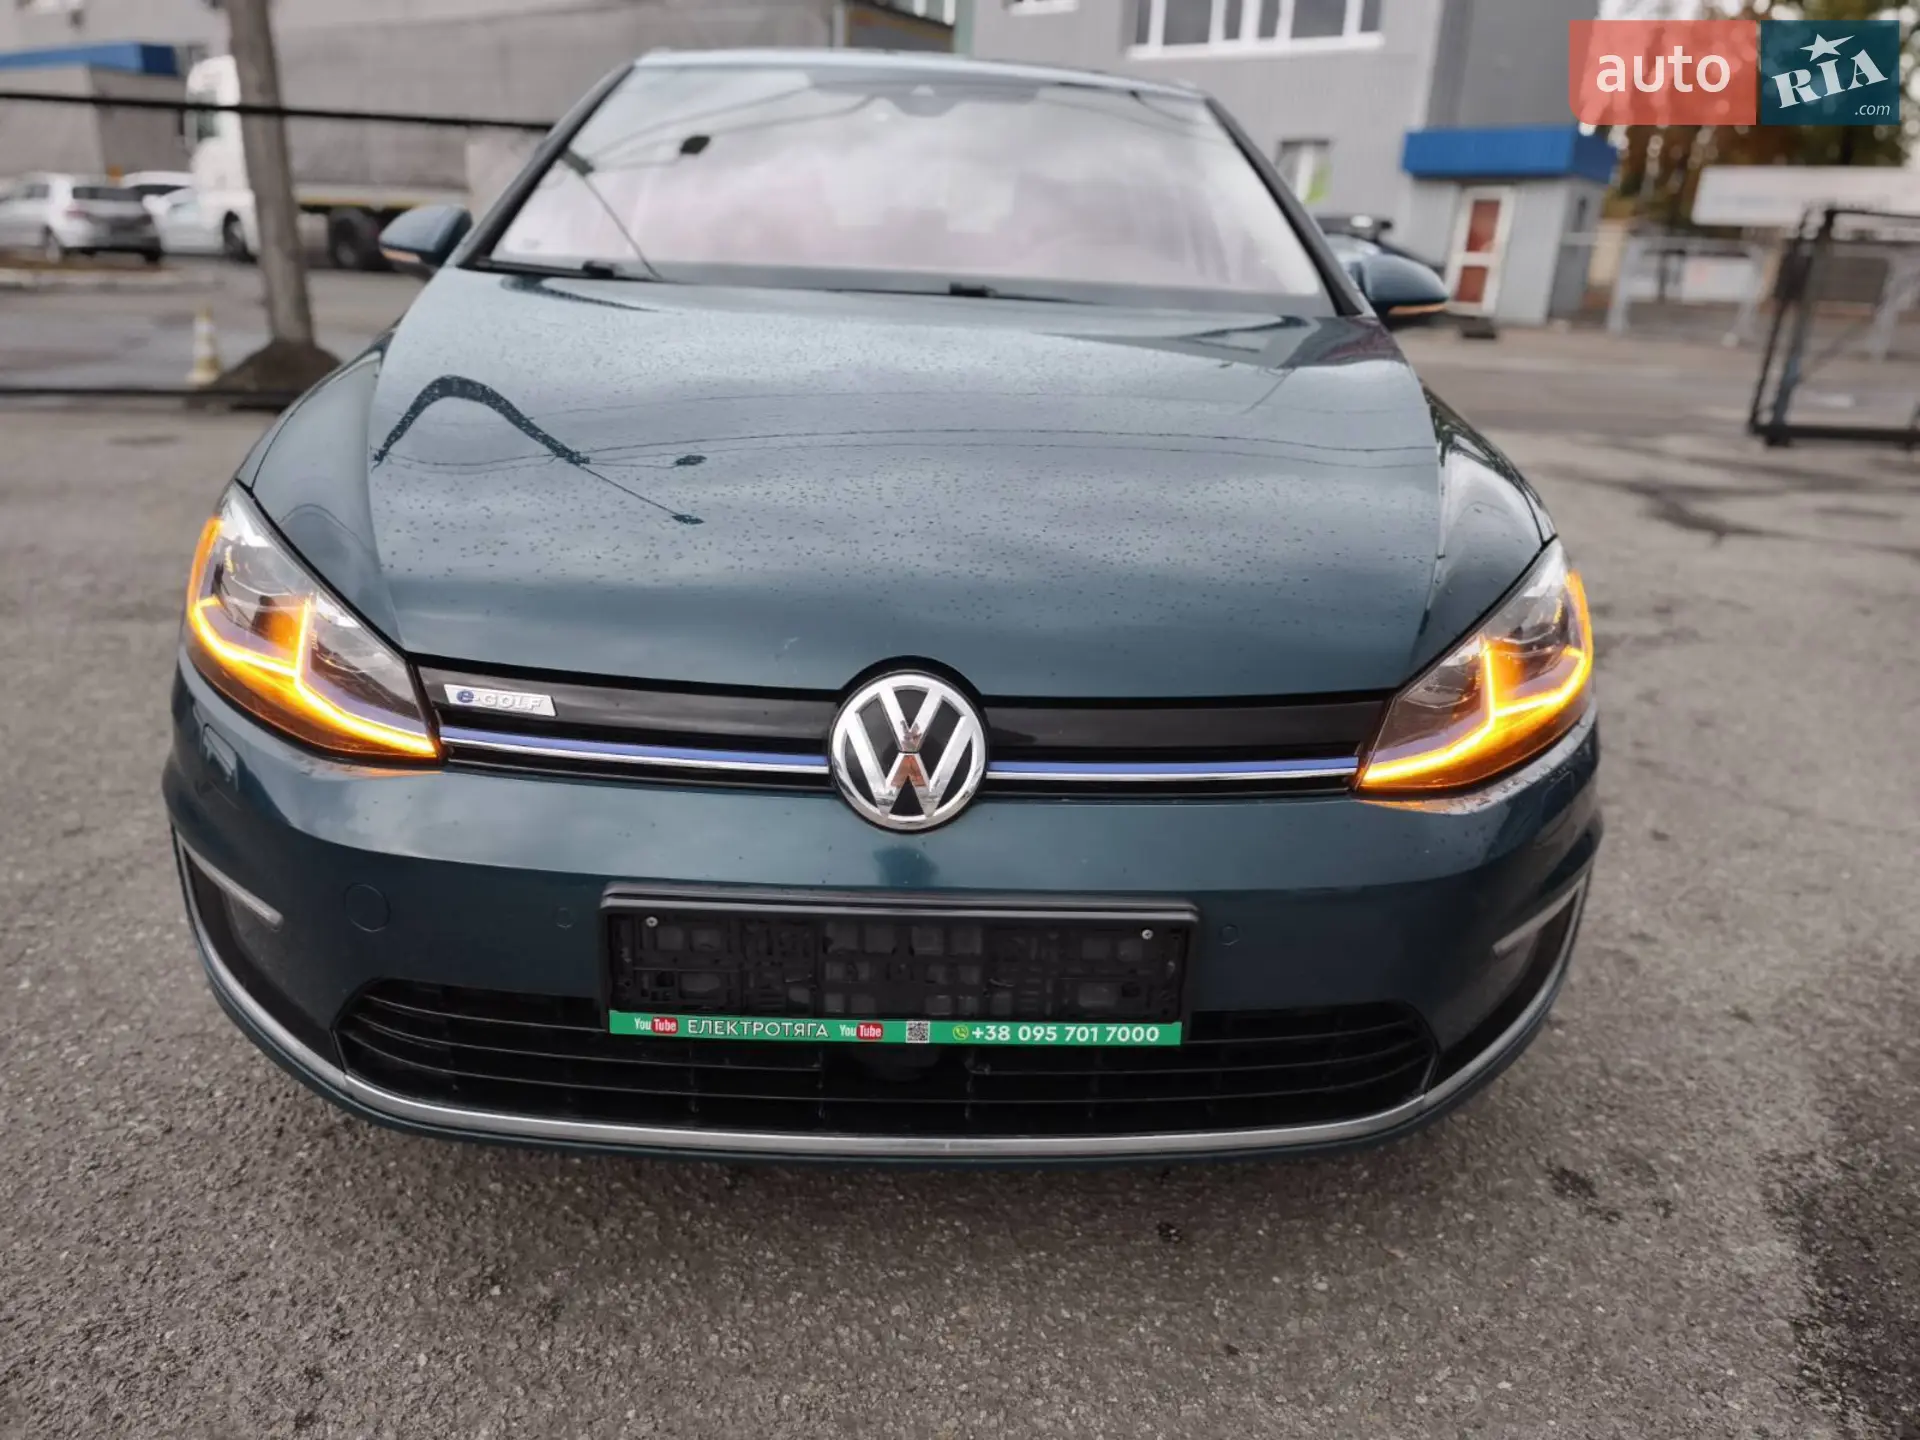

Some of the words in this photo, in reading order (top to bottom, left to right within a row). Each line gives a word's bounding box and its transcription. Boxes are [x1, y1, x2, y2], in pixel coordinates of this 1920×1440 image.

[687, 1019, 829, 1038] ЕЛЕКТРОТЯГА
[972, 1025, 1011, 1041] +38
[1018, 1025, 1057, 1042] 095
[1064, 1026, 1098, 1042] 701
[1105, 1026, 1159, 1043] 7000
